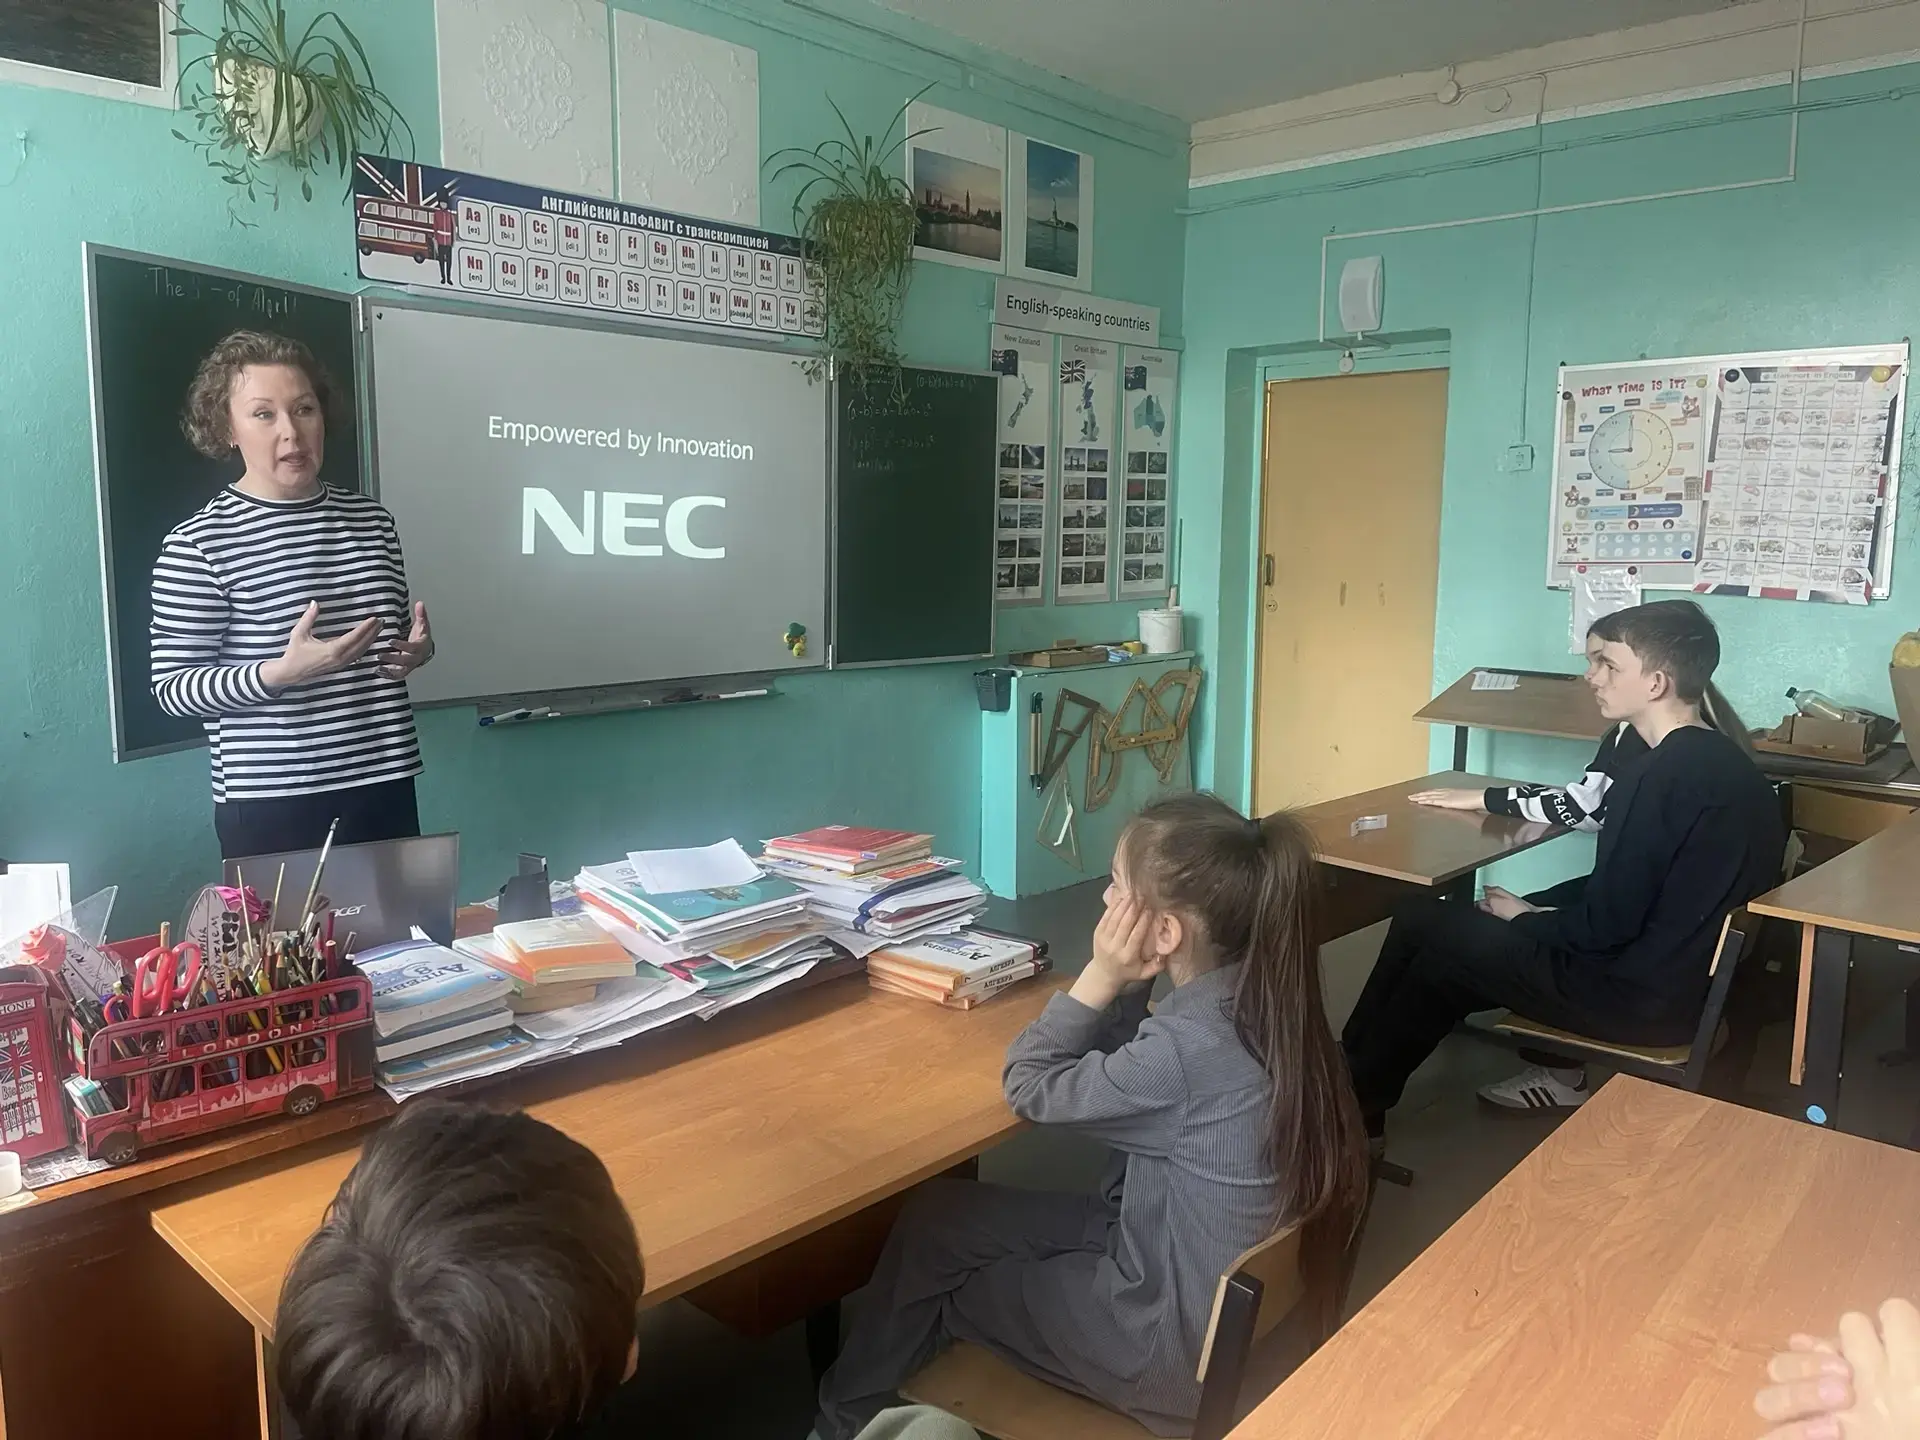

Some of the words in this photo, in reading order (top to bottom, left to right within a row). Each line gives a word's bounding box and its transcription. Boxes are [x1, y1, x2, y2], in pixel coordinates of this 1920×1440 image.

[466, 208, 481, 222] Aa
[500, 214, 514, 228] Bb
[532, 220, 547, 234] Cc
[565, 225, 578, 239] Dd
[596, 231, 608, 244] Ee
[628, 236, 637, 249] Ff
[654, 241, 667, 255] Gg
[682, 246, 694, 259] Hh
[760, 259, 771, 272] Kk
[541, 196, 620, 223] АНГЛИЙСКИЙ
[622, 211, 674, 233] АЛФАВИТ
[685, 225, 769, 250] транскрипцией
[148, 267, 185, 298] The
[227, 284, 243, 307] of
[467, 256, 482, 270] Nn
[502, 261, 516, 275] Oo
[535, 265, 548, 280] Pp
[566, 270, 579, 285] Qq
[597, 275, 609, 288] Rr
[627, 280, 639, 293] Ss
[656, 284, 666, 297] Tt
[683, 288, 695, 300] Uu
[710, 292, 721, 305] Vv
[733, 295, 749, 308] Ww
[761, 299, 771, 311] Xx
[786, 302, 795, 315] Yy
[1006, 295, 1102, 326] English-speaking
[1103, 313, 1150, 331] countries
[1004, 333, 1017, 343] New
[1018, 336, 1041, 346] Zealand
[1074, 344, 1089, 354] Great
[1090, 346, 1107, 355] Britain
[1141, 354, 1163, 363] Australia
[488, 416, 620, 448] Empowered
[628, 429, 651, 456] by
[657, 432, 754, 460] Innovation
[521, 487, 726, 559] NEC
[1553, 792, 1577, 826] PEACE
[182, 1023, 302, 1057] LONDON
